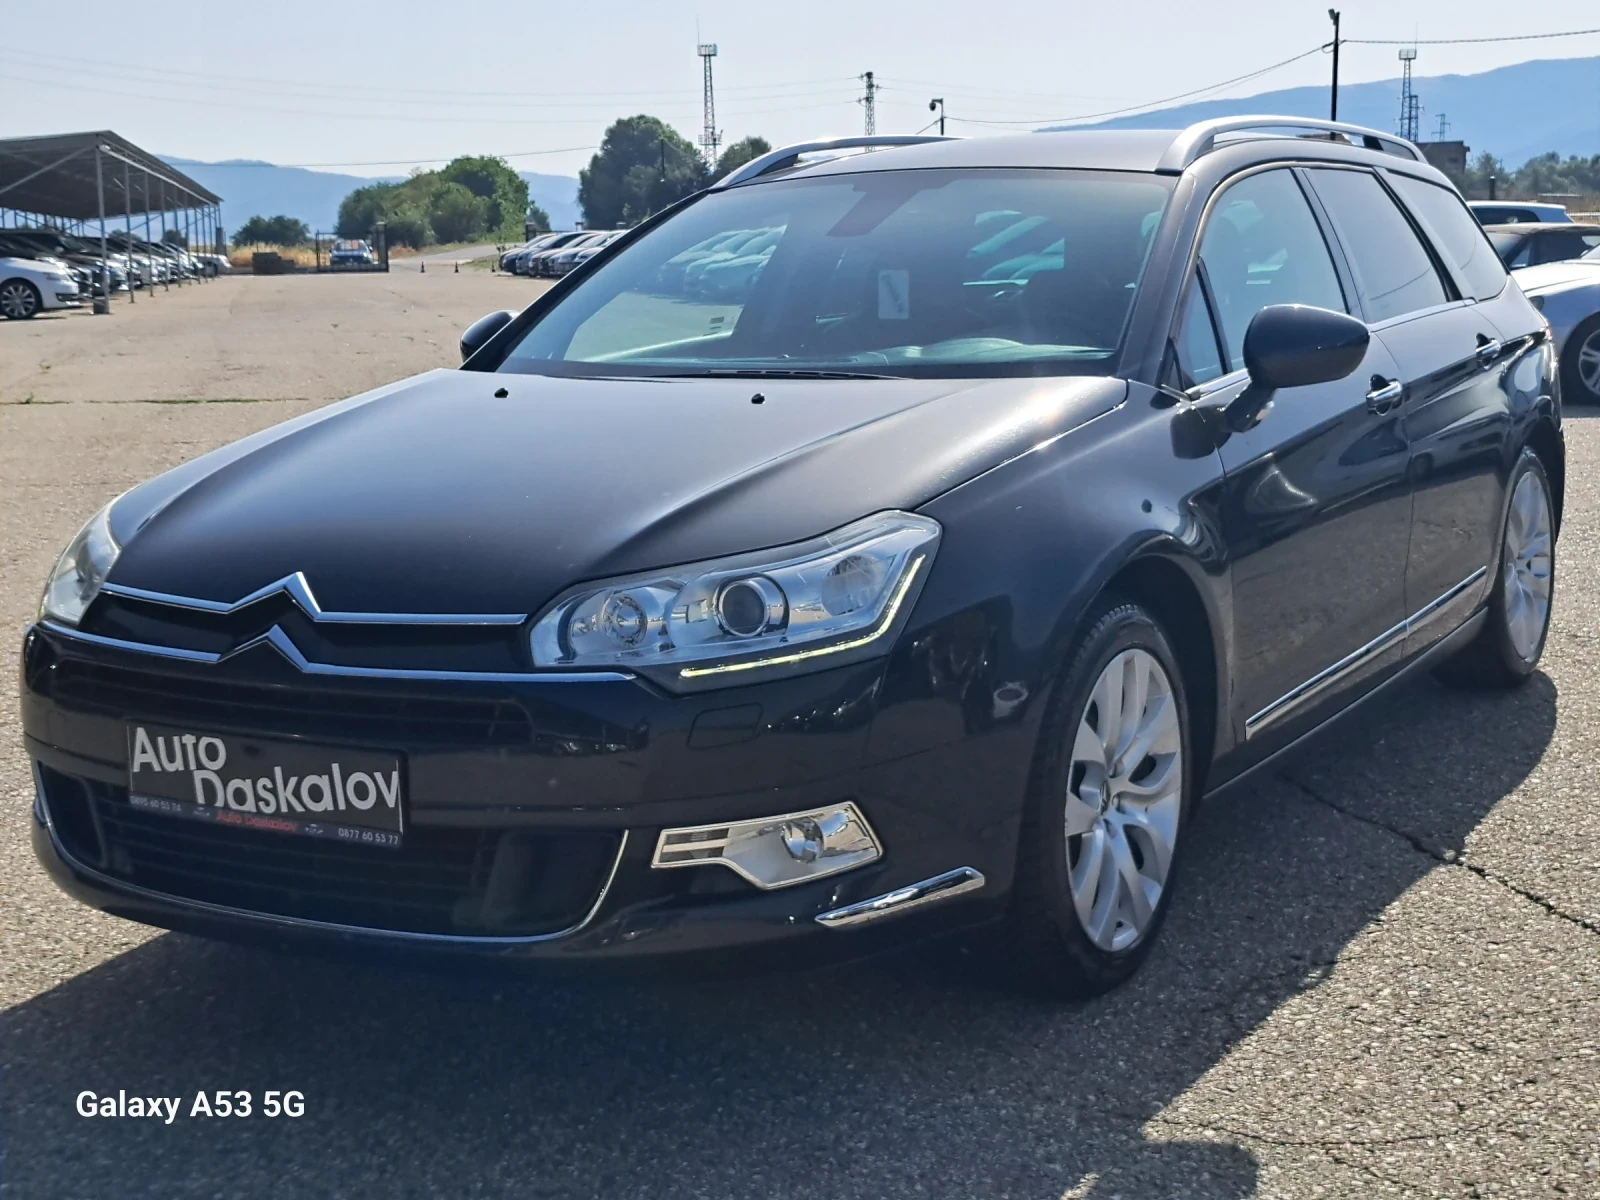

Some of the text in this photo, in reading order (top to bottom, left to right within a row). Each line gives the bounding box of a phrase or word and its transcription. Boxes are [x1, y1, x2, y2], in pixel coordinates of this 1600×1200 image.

[132, 727, 227, 773] Auto
[193, 763, 399, 814] Daskalov
[338, 827, 399, 845] 0877 60 53 77
